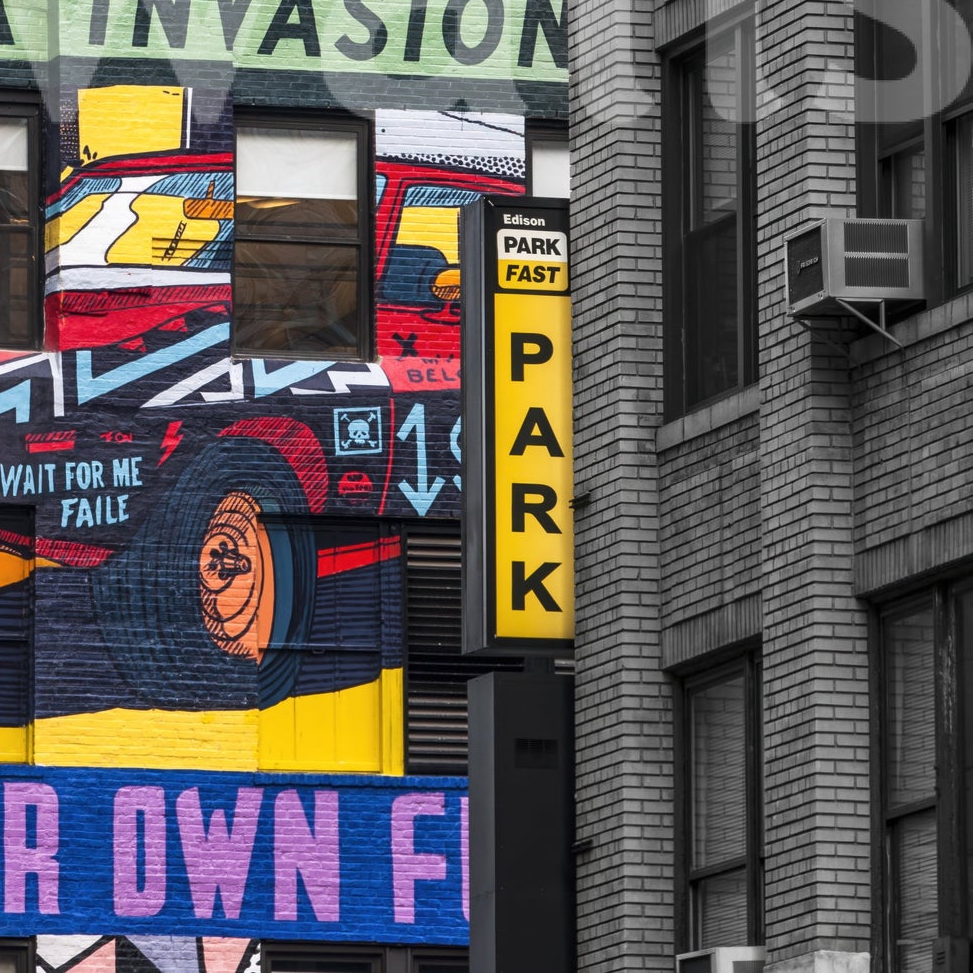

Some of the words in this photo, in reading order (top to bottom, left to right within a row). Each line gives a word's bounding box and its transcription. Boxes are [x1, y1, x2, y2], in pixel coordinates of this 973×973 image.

[503, 214, 546, 227] Edison
[503, 236, 562, 256] PARK
[505, 264, 561, 284] FAST
[0, 463, 56, 498] WAIT
[65, 460, 104, 491] FOR
[112, 456, 143, 487] ME
[509, 332, 565, 613] PARK
[61, 494, 130, 528] FAILE
[113, 786, 341, 923] OWN
